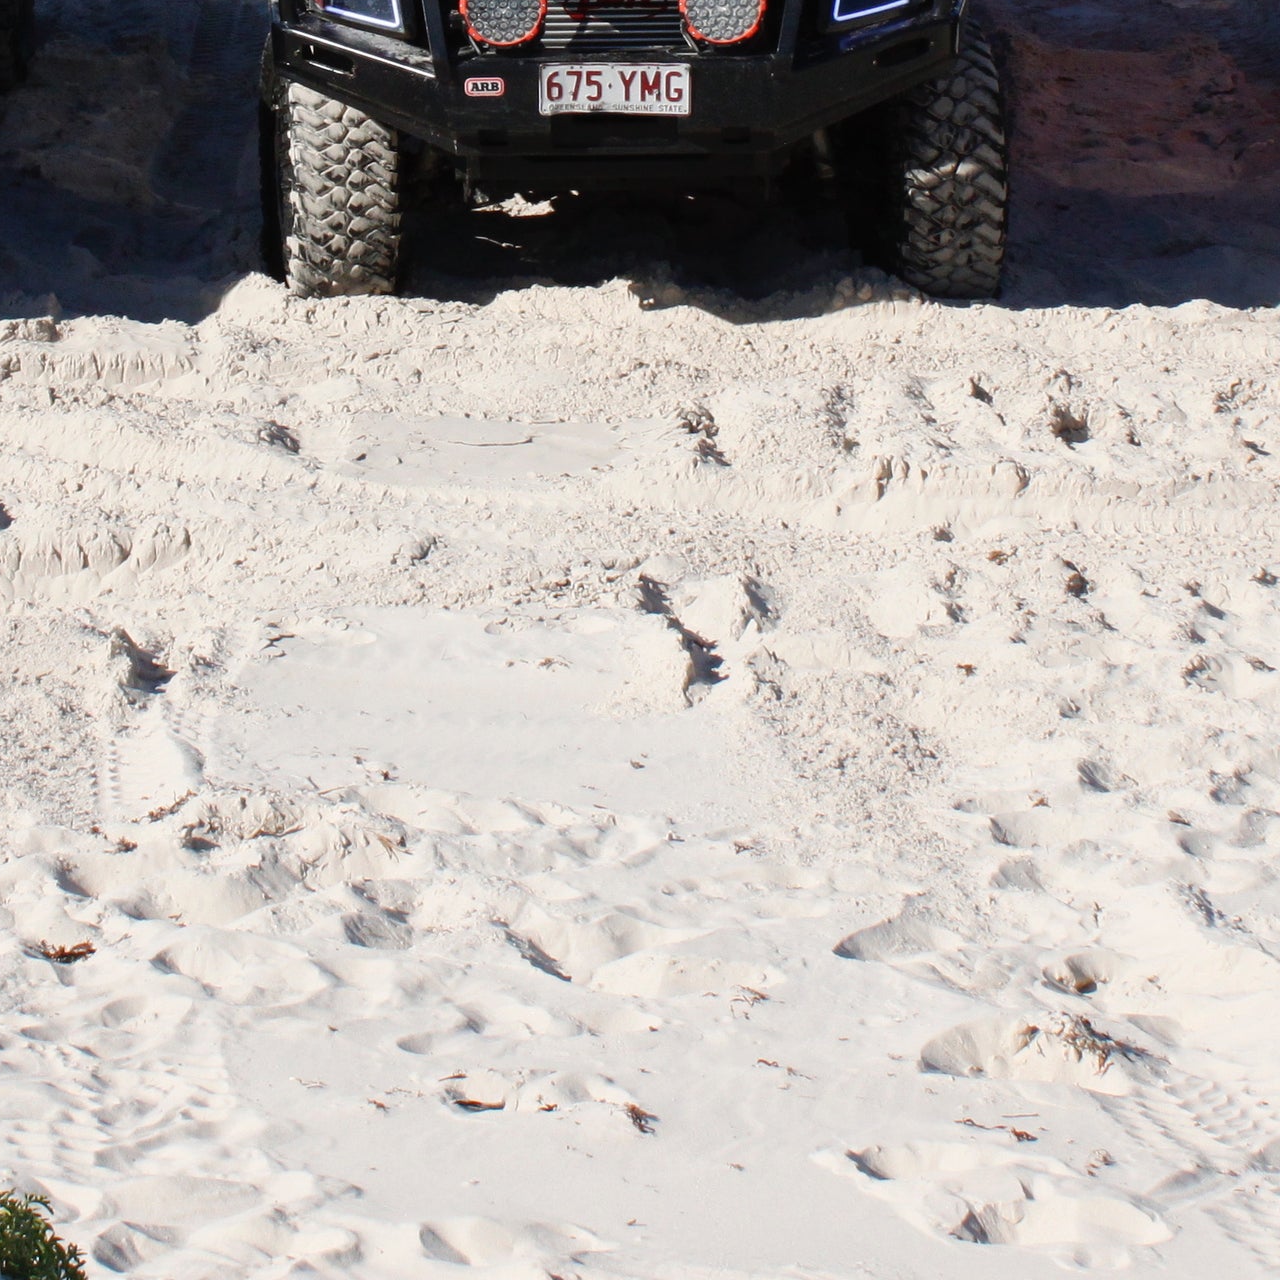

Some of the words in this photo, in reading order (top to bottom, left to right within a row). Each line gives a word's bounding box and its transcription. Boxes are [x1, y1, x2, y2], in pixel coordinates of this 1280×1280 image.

[470, 81, 500, 92] ARB
[612, 103, 654, 113] SUNSHINE
[658, 104, 684, 113] STATE
